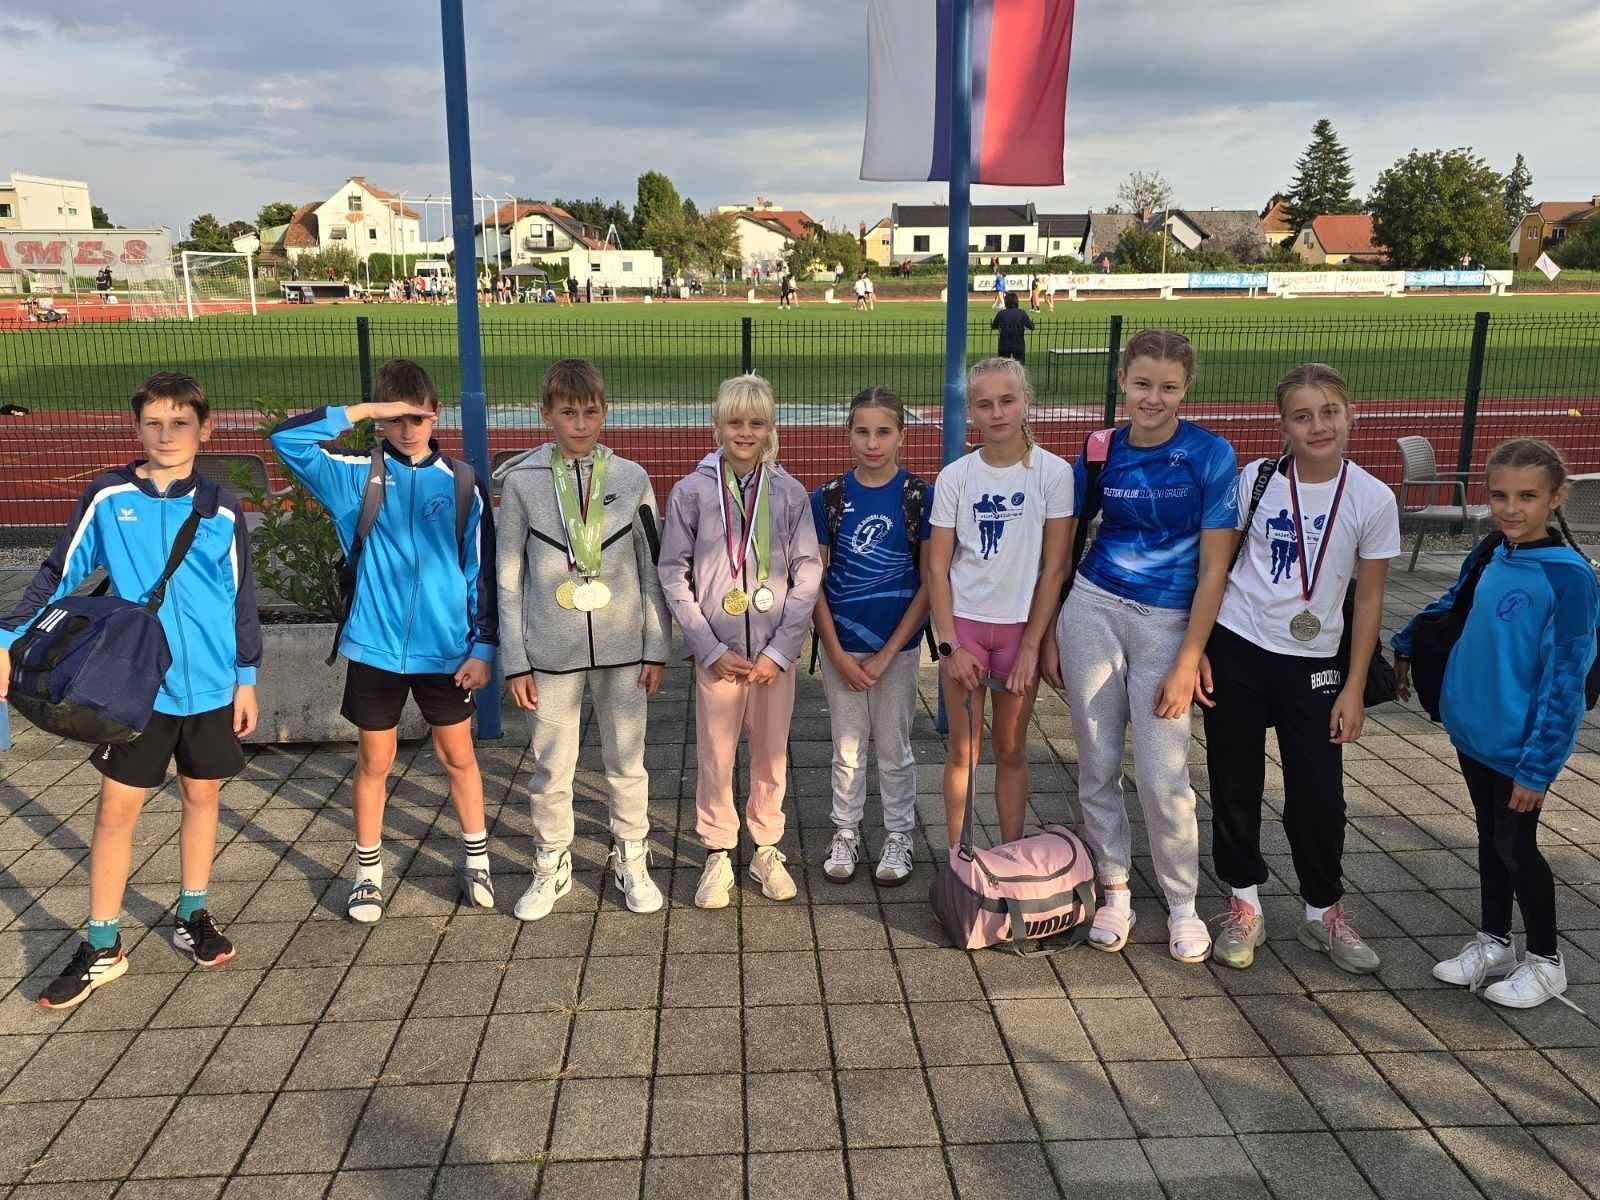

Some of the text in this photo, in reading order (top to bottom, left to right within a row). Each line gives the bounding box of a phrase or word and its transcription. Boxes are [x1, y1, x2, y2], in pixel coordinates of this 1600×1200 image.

[1202, 274, 1229, 285] JAKO
[1241, 274, 1267, 285] JAKO
[1272, 274, 1328, 286] HyperCUT
[1103, 487, 1124, 498] TLETSKI
[1123, 488, 1139, 499] KLUB
[1024, 911, 1074, 936] UMA
